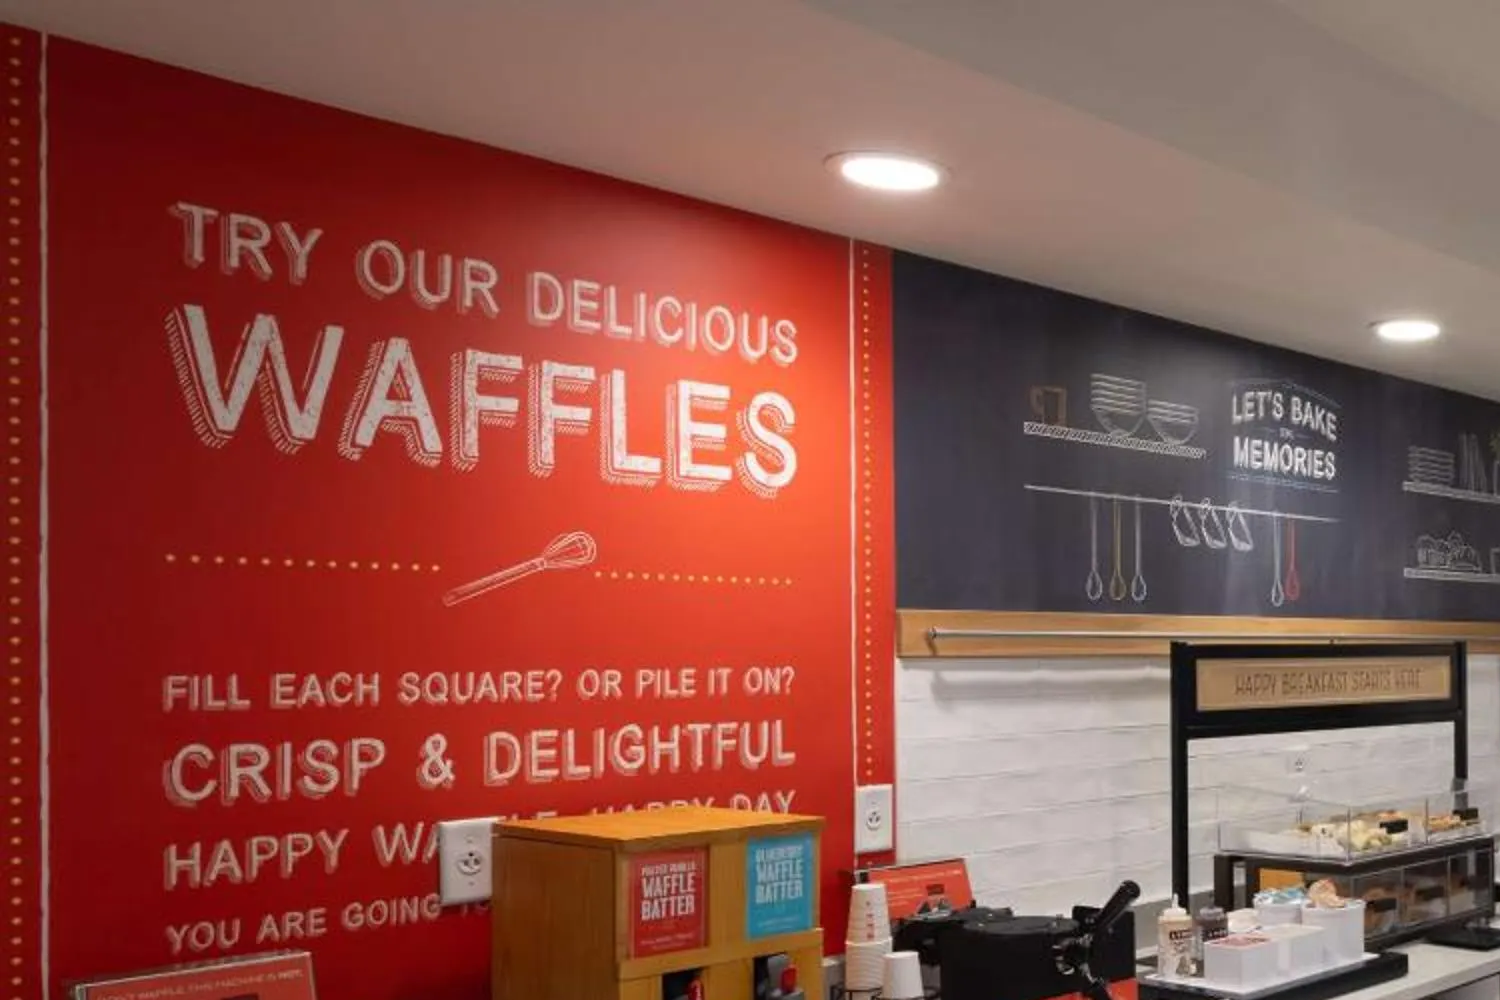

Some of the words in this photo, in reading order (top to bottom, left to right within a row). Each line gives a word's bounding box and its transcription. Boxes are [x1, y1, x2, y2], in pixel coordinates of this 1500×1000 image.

[168, 201, 323, 285] TRY
[356, 239, 500, 317] OUR
[526, 272, 798, 366] DELICIOUS
[165, 303, 798, 498] WAFFLES
[1232, 390, 1284, 425] LET'S
[1291, 396, 1337, 441] BAKE
[1233, 436, 1336, 480] MEMORIES
[163, 674, 250, 712] FILL
[270, 671, 380, 708] EACH
[397, 668, 563, 705] SQUARE?
[577, 668, 622, 699] OR
[635, 667, 697, 699] PILE
[707, 667, 732, 696] IT
[744, 665, 796, 695] ON?
[1234, 672, 1277, 697] HAPPY
[1281, 670, 1350, 696] BREAKFAST
[1352, 668, 1392, 691] STARTS
[162, 737, 386, 807] CRISP
[416, 733, 454, 789] &
[484, 719, 796, 787] DELIGHTFUL
[163, 828, 350, 890] HAPPY
[756, 858, 804, 884] WAFFLE
[641, 894, 695, 922] BATTER
[642, 871, 696, 899] WAFFLE
[755, 878, 804, 905] BATTER
[165, 919, 240, 953] YOU
[256, 907, 327, 945] ARE
[341, 893, 441, 932] GOING
